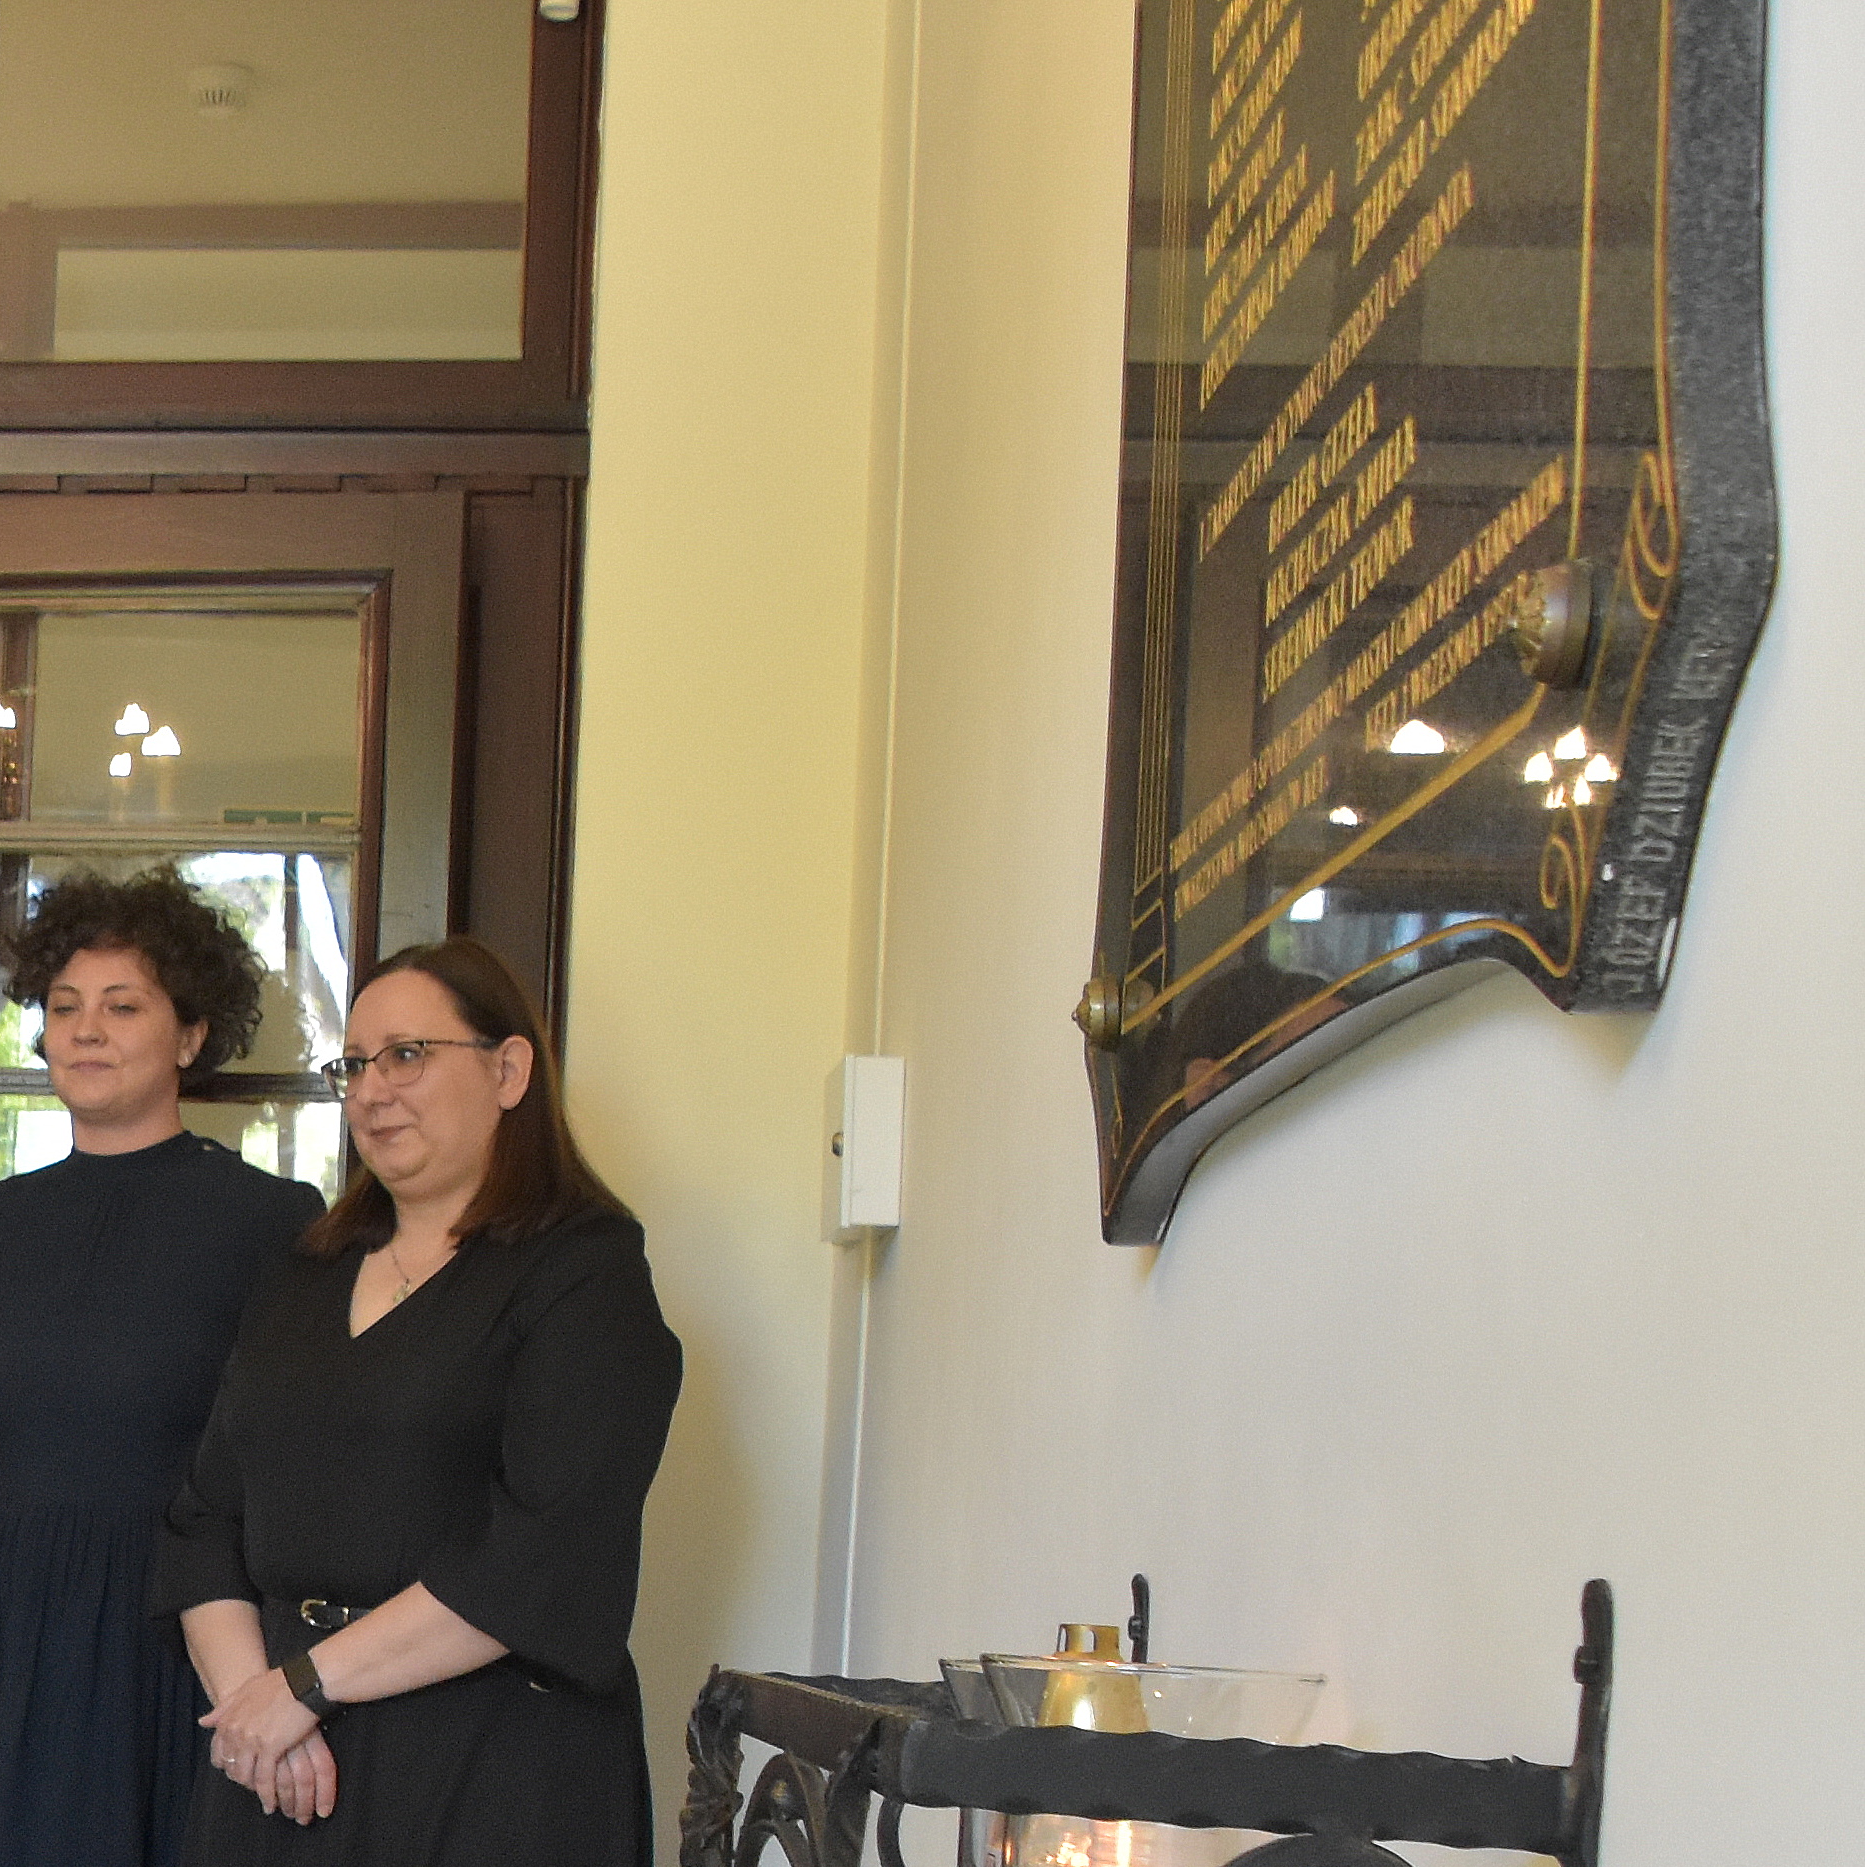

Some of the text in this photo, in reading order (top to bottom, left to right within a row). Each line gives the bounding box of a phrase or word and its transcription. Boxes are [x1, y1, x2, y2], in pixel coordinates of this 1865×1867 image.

[1237, 109, 1284, 223] RUDOLF
[1388, 160, 1472, 310] OKUPANTA
[1320, 382, 1376, 490] GIZELA
[1345, 629, 1389, 704] MIASTA
[1474, 455, 1564, 586] STARANIEM
[1350, 494, 1414, 612] TEODOR
[1627, 714, 1711, 864] DZIUBEK
